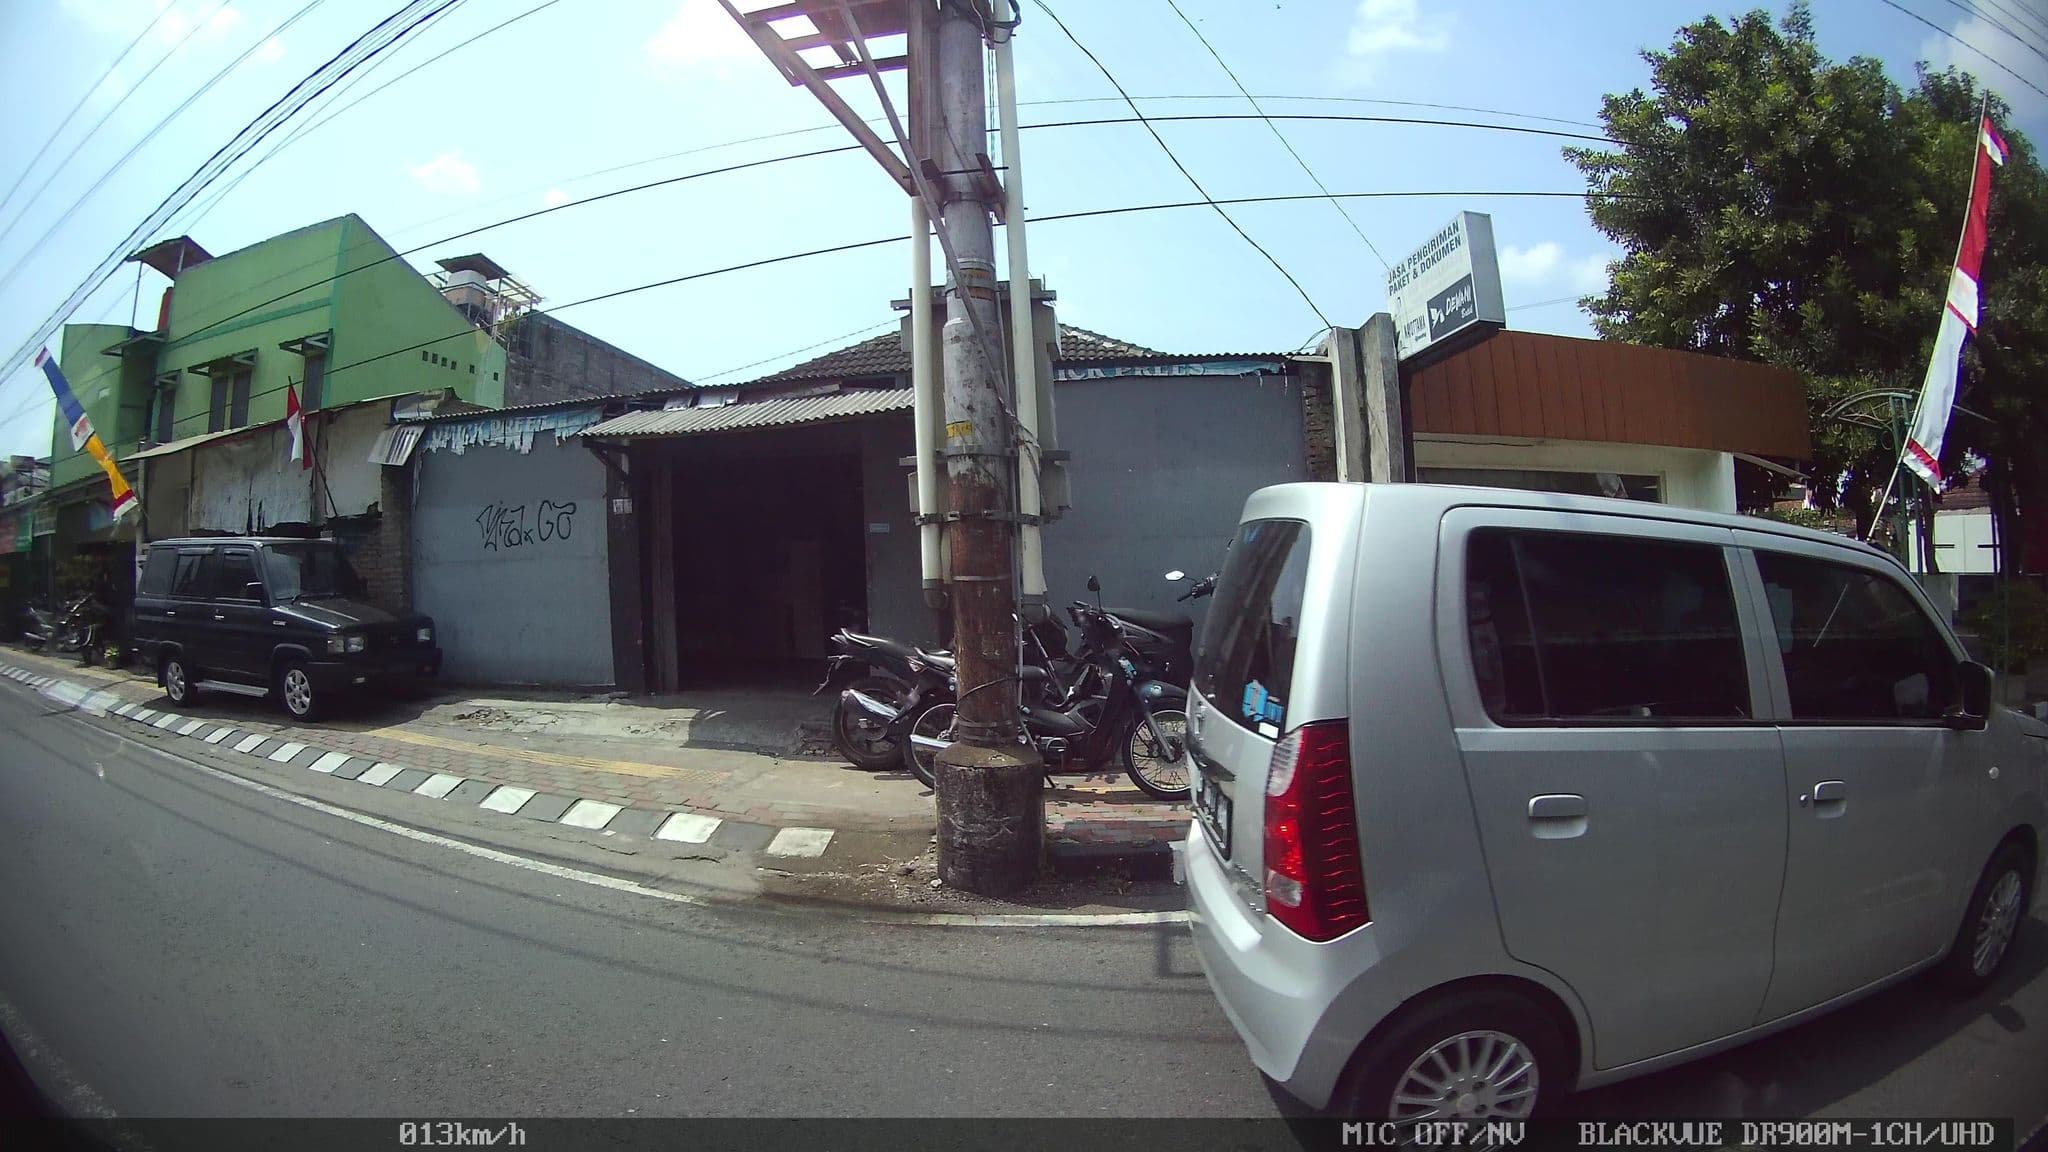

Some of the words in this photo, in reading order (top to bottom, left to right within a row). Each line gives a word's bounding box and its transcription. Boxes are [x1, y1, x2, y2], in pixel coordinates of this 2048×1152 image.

[1388, 263, 1406, 284] JASA
[1407, 221, 1459, 269] PENGIRIMAN
[1389, 273, 1410, 296] PAKET
[1413, 268, 1418, 279] &
[1420, 235, 1461, 274] DOKUMEN
